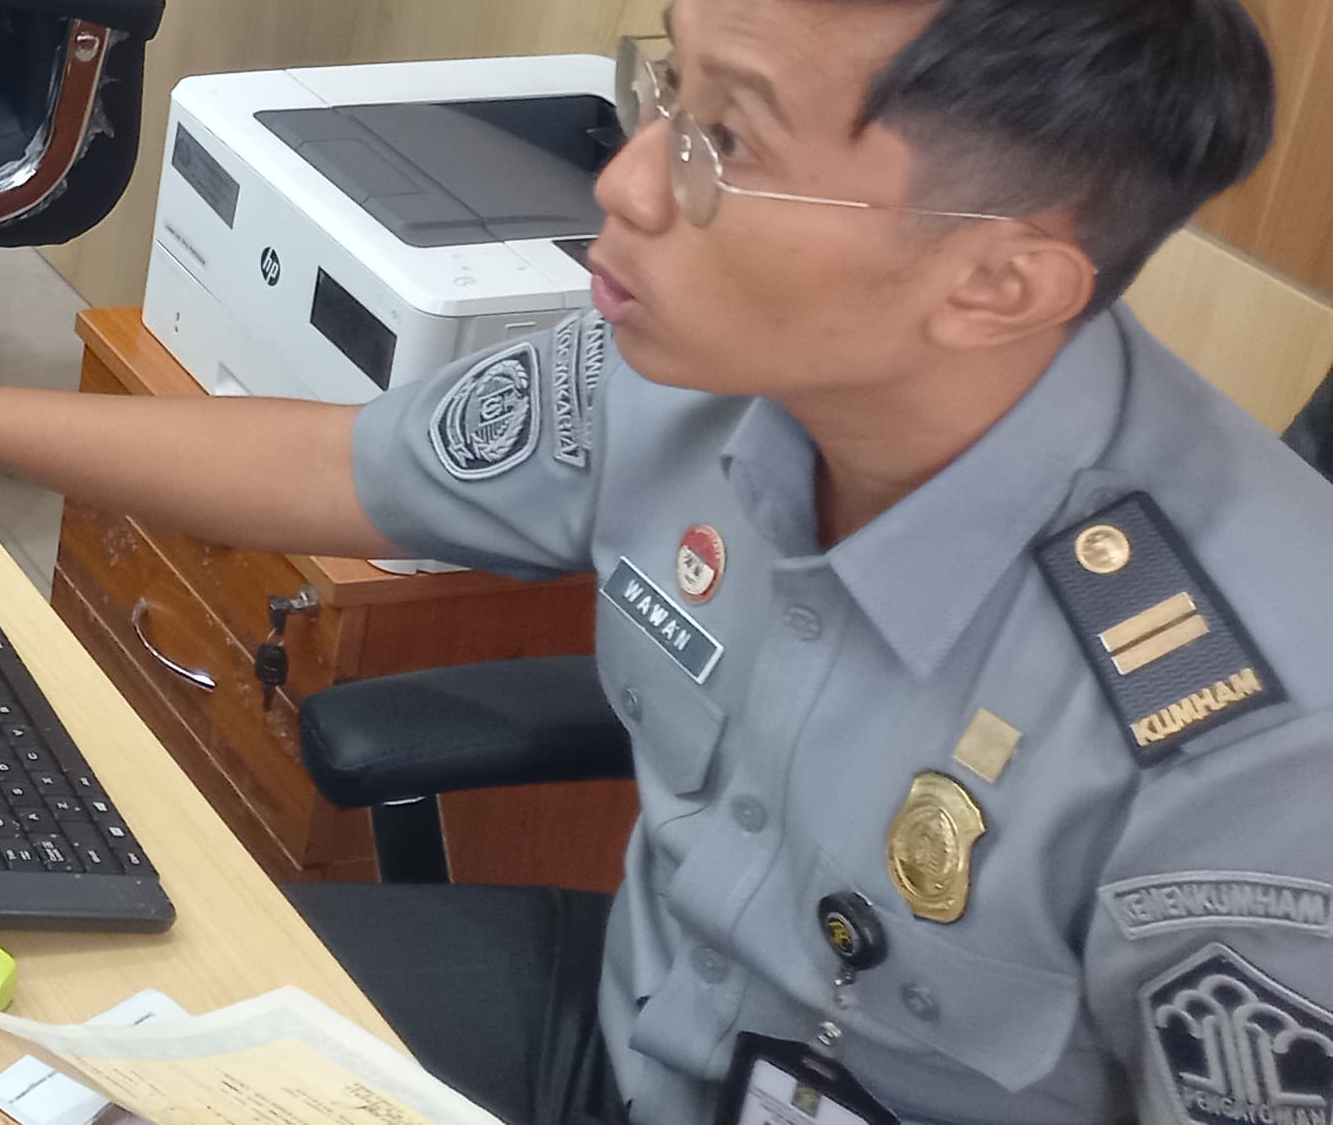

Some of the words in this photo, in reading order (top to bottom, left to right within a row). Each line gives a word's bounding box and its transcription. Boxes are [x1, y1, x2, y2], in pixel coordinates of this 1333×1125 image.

[261, 247, 280, 286] hp
[623, 579, 691, 651] WAWAN
[1130, 667, 1262, 747] KUMHAM
